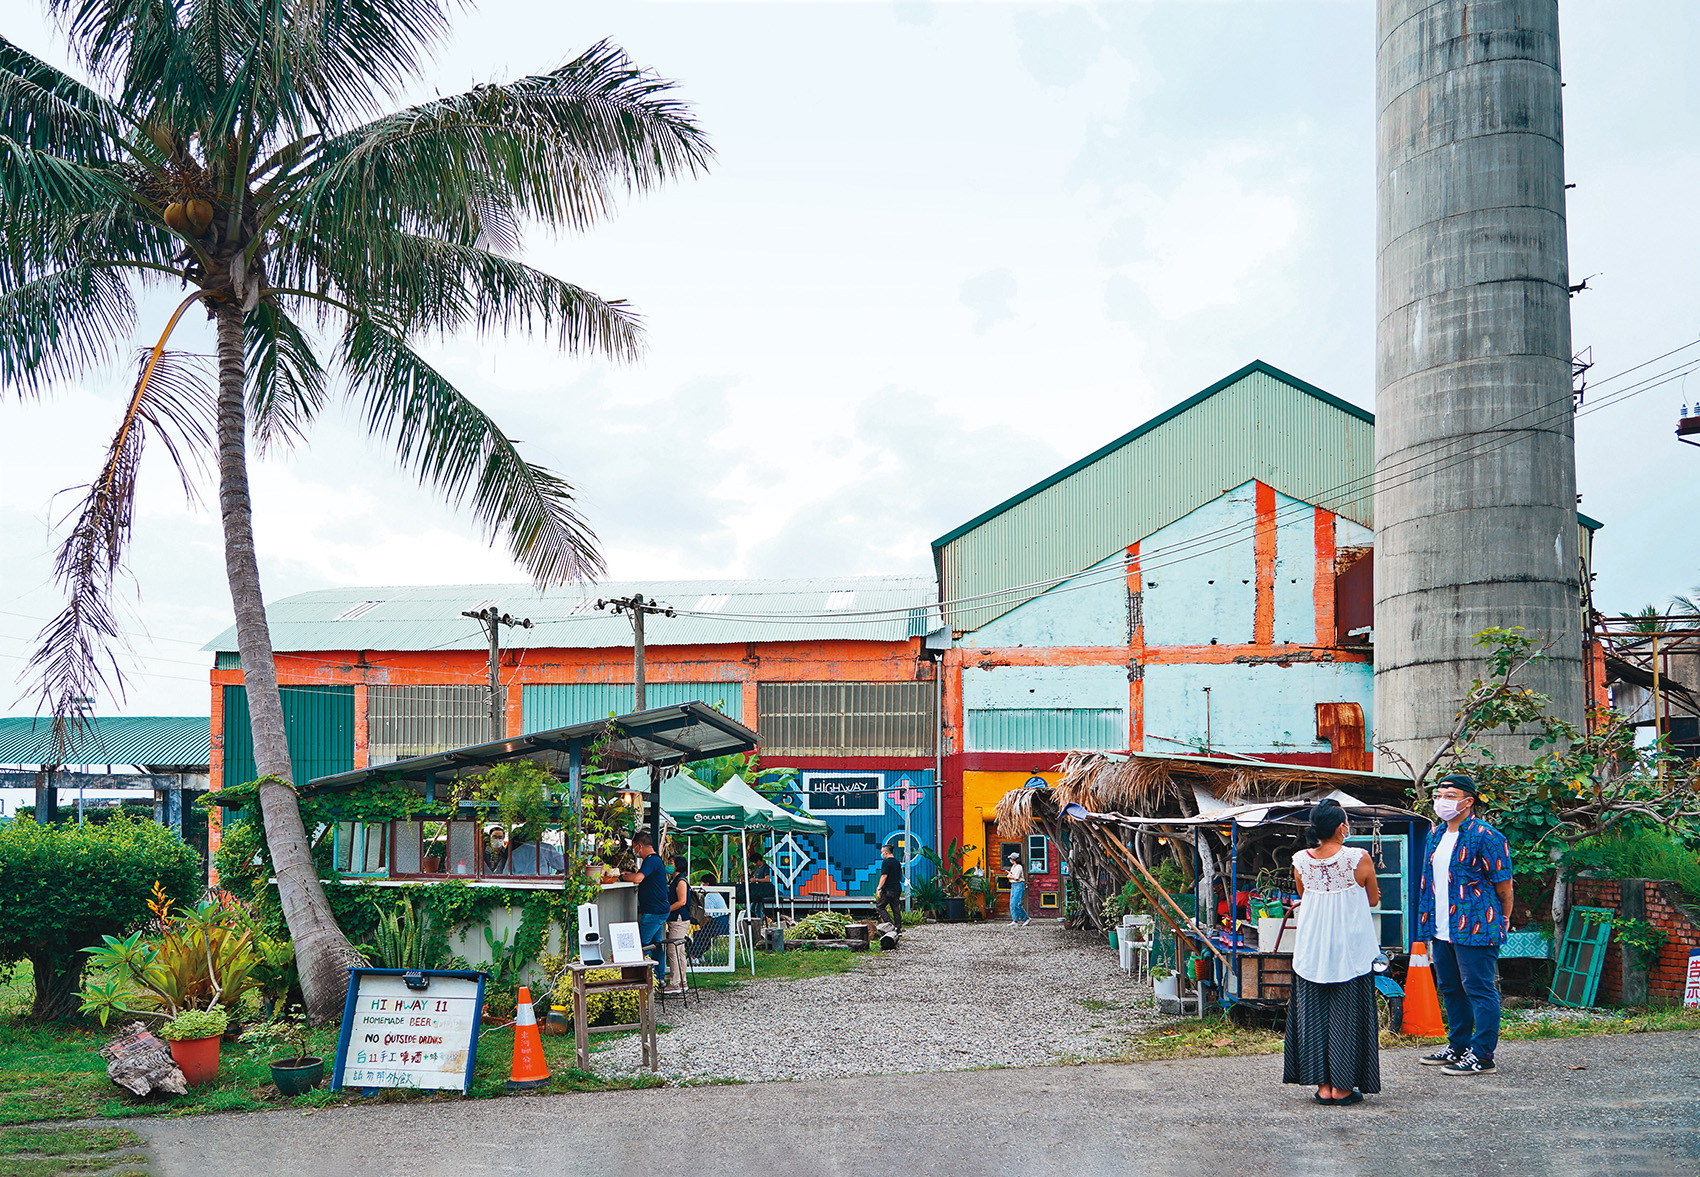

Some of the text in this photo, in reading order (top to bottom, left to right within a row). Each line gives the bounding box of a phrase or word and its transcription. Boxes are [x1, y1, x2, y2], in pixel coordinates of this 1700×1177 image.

[834, 794, 846, 807] 11
[371, 999, 448, 1012] HIGHWAY 11
[363, 1016, 405, 1025] HOMEMADE
[365, 1032, 443, 1045] NO OUTSIDE DRINKS
